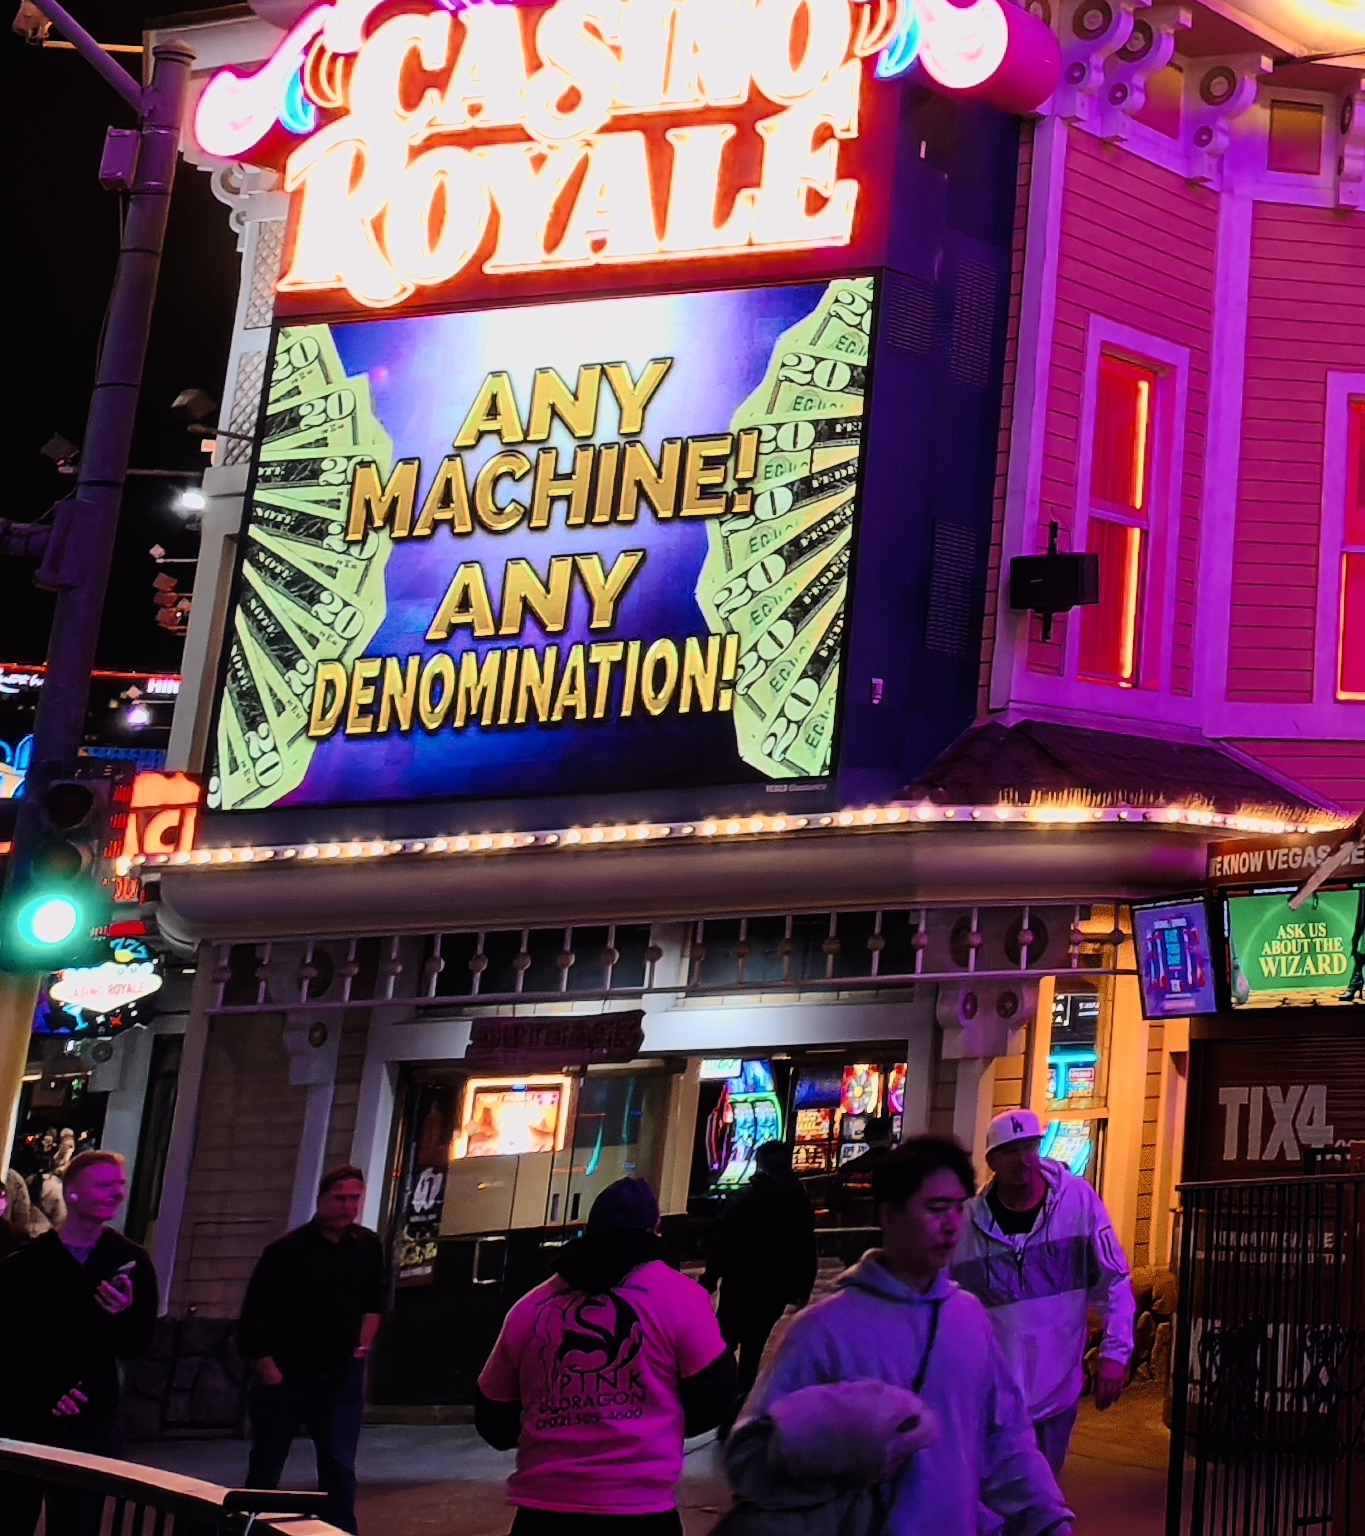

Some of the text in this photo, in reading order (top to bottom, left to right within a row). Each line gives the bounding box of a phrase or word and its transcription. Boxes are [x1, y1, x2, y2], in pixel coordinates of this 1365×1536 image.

[277, 65, 862, 310] ROYALE
[778, 353, 852, 392] 20
[299, 389, 357, 430] 20
[454, 357, 674, 450] ANY
[345, 428, 763, 544] MACHINE!
[425, 548, 645, 641] ANY
[712, 553, 787, 618] 20
[310, 590, 366, 640] 20
[308, 633, 741, 739] DENOMINATION!
[761, 677, 819, 762] 20
[1223, 851, 1264, 877] KNOW
[1266, 845, 1332, 870] VEGAS
[1261, 936, 1344, 956] ABOUT THE
[1276, 922, 1327, 940] ASK US
[1258, 953, 1348, 978] WIZARD
[1218, 1084, 1334, 1161] TIX4
[560, 1370, 646, 1394] PINK
[560, 1390, 647, 1411] DRAGON
